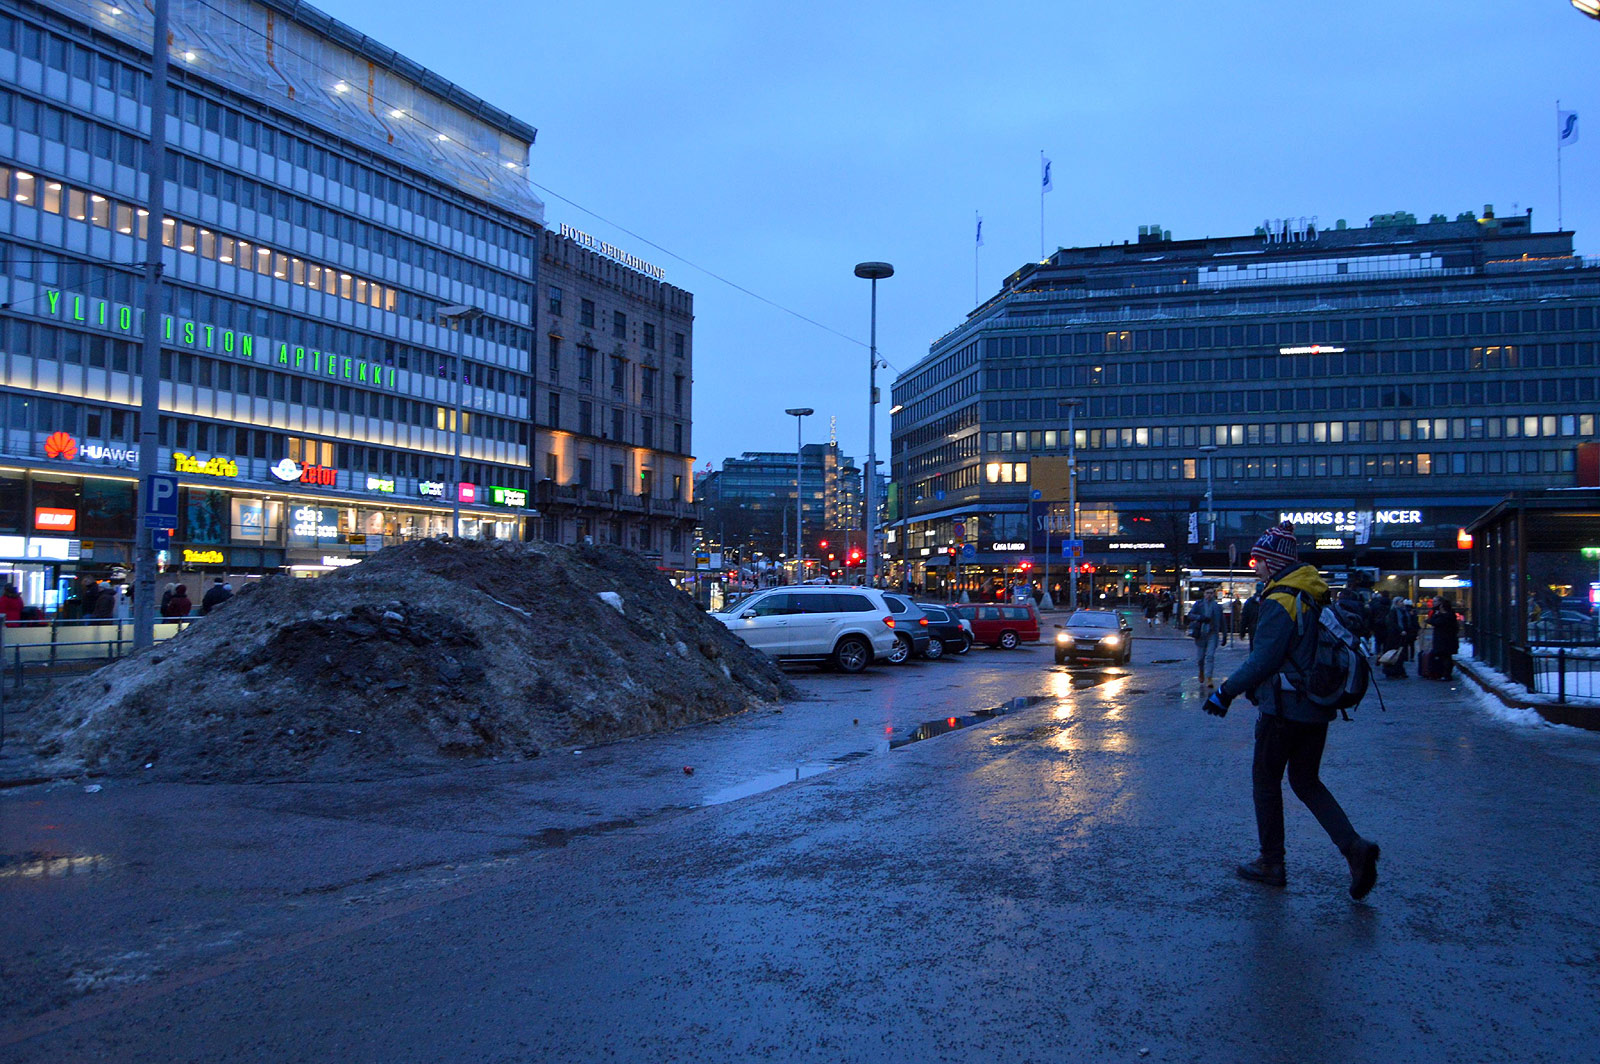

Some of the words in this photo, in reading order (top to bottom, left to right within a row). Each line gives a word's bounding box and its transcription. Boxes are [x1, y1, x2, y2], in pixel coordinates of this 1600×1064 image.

[560, 223, 598, 250] HOTEL
[600, 241, 667, 280] SEURAHUONE
[47, 290, 253, 357] YLIOISTON
[279, 344, 395, 388] APTEEKKI
[80, 444, 139, 462] HUAWEI
[299, 461, 338, 487] Zetor
[152, 477, 174, 512] P
[1279, 511, 1333, 525] MARKS
[1335, 511, 1345, 525] &
[1391, 540, 1413, 548] COFFEE
[1415, 540, 1436, 548] HOUSE
